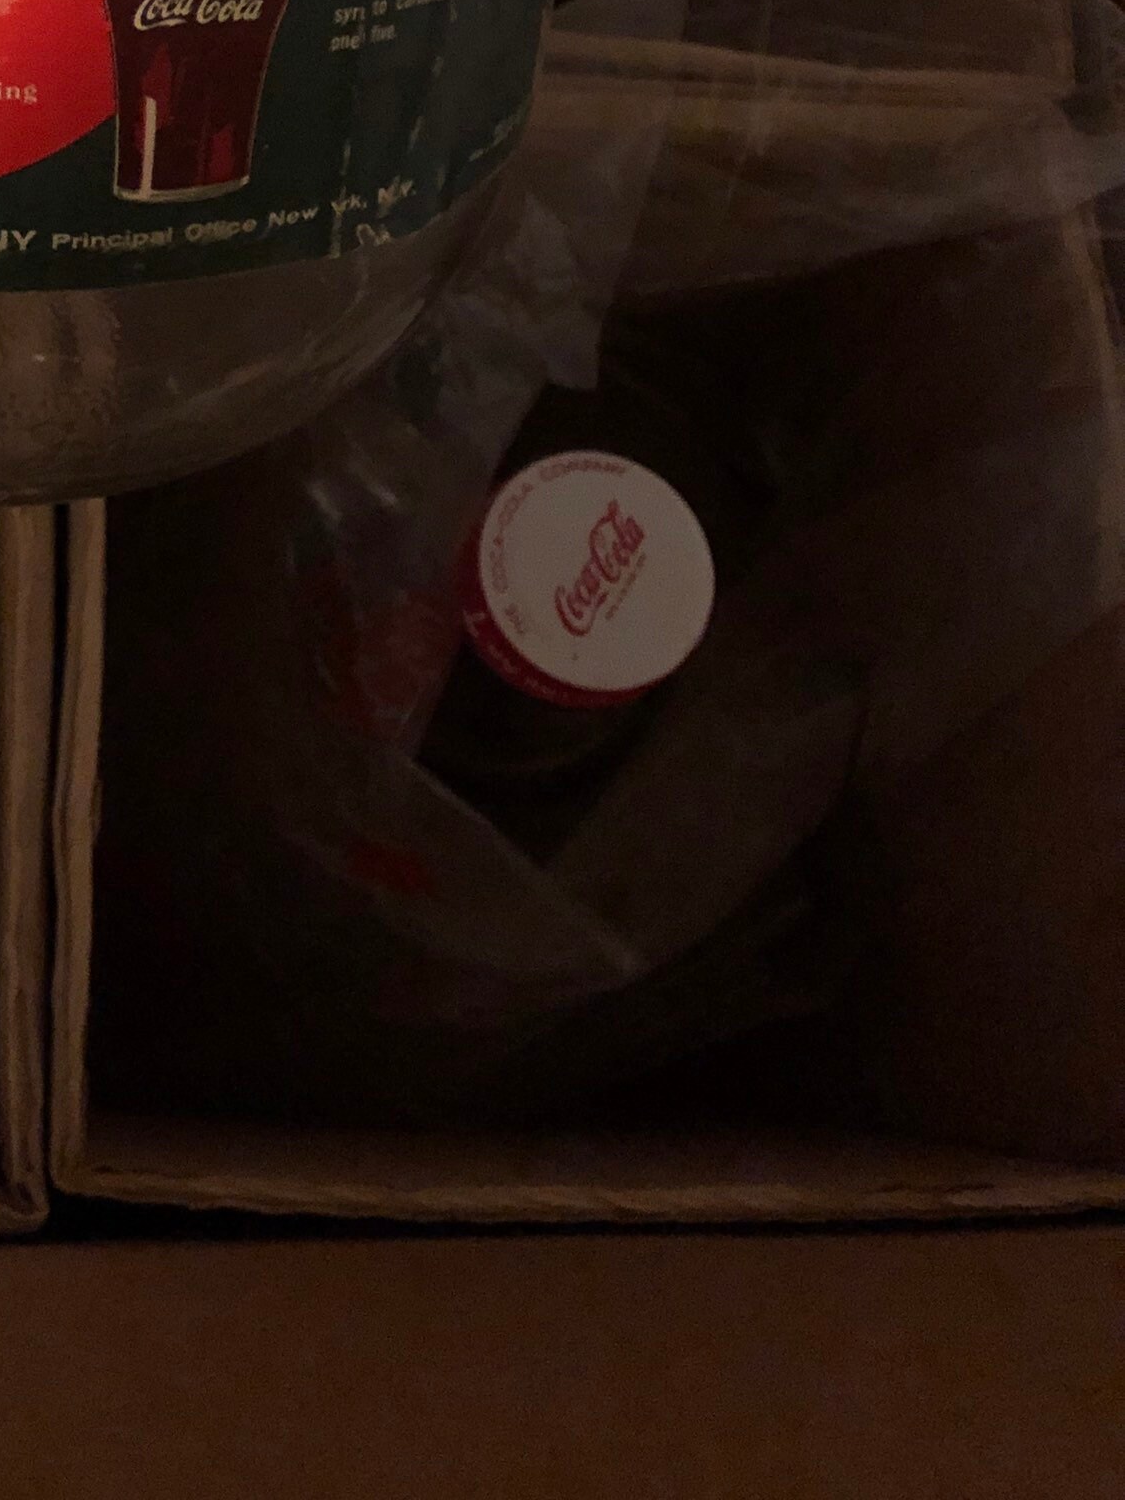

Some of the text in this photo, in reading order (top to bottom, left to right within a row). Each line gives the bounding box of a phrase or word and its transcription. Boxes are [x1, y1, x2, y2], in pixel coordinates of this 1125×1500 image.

[51, 228, 174, 251] Principal
[184, 217, 258, 241] Office
[268, 206, 319, 228] New
[553, 498, 646, 640] Coca-Cola
